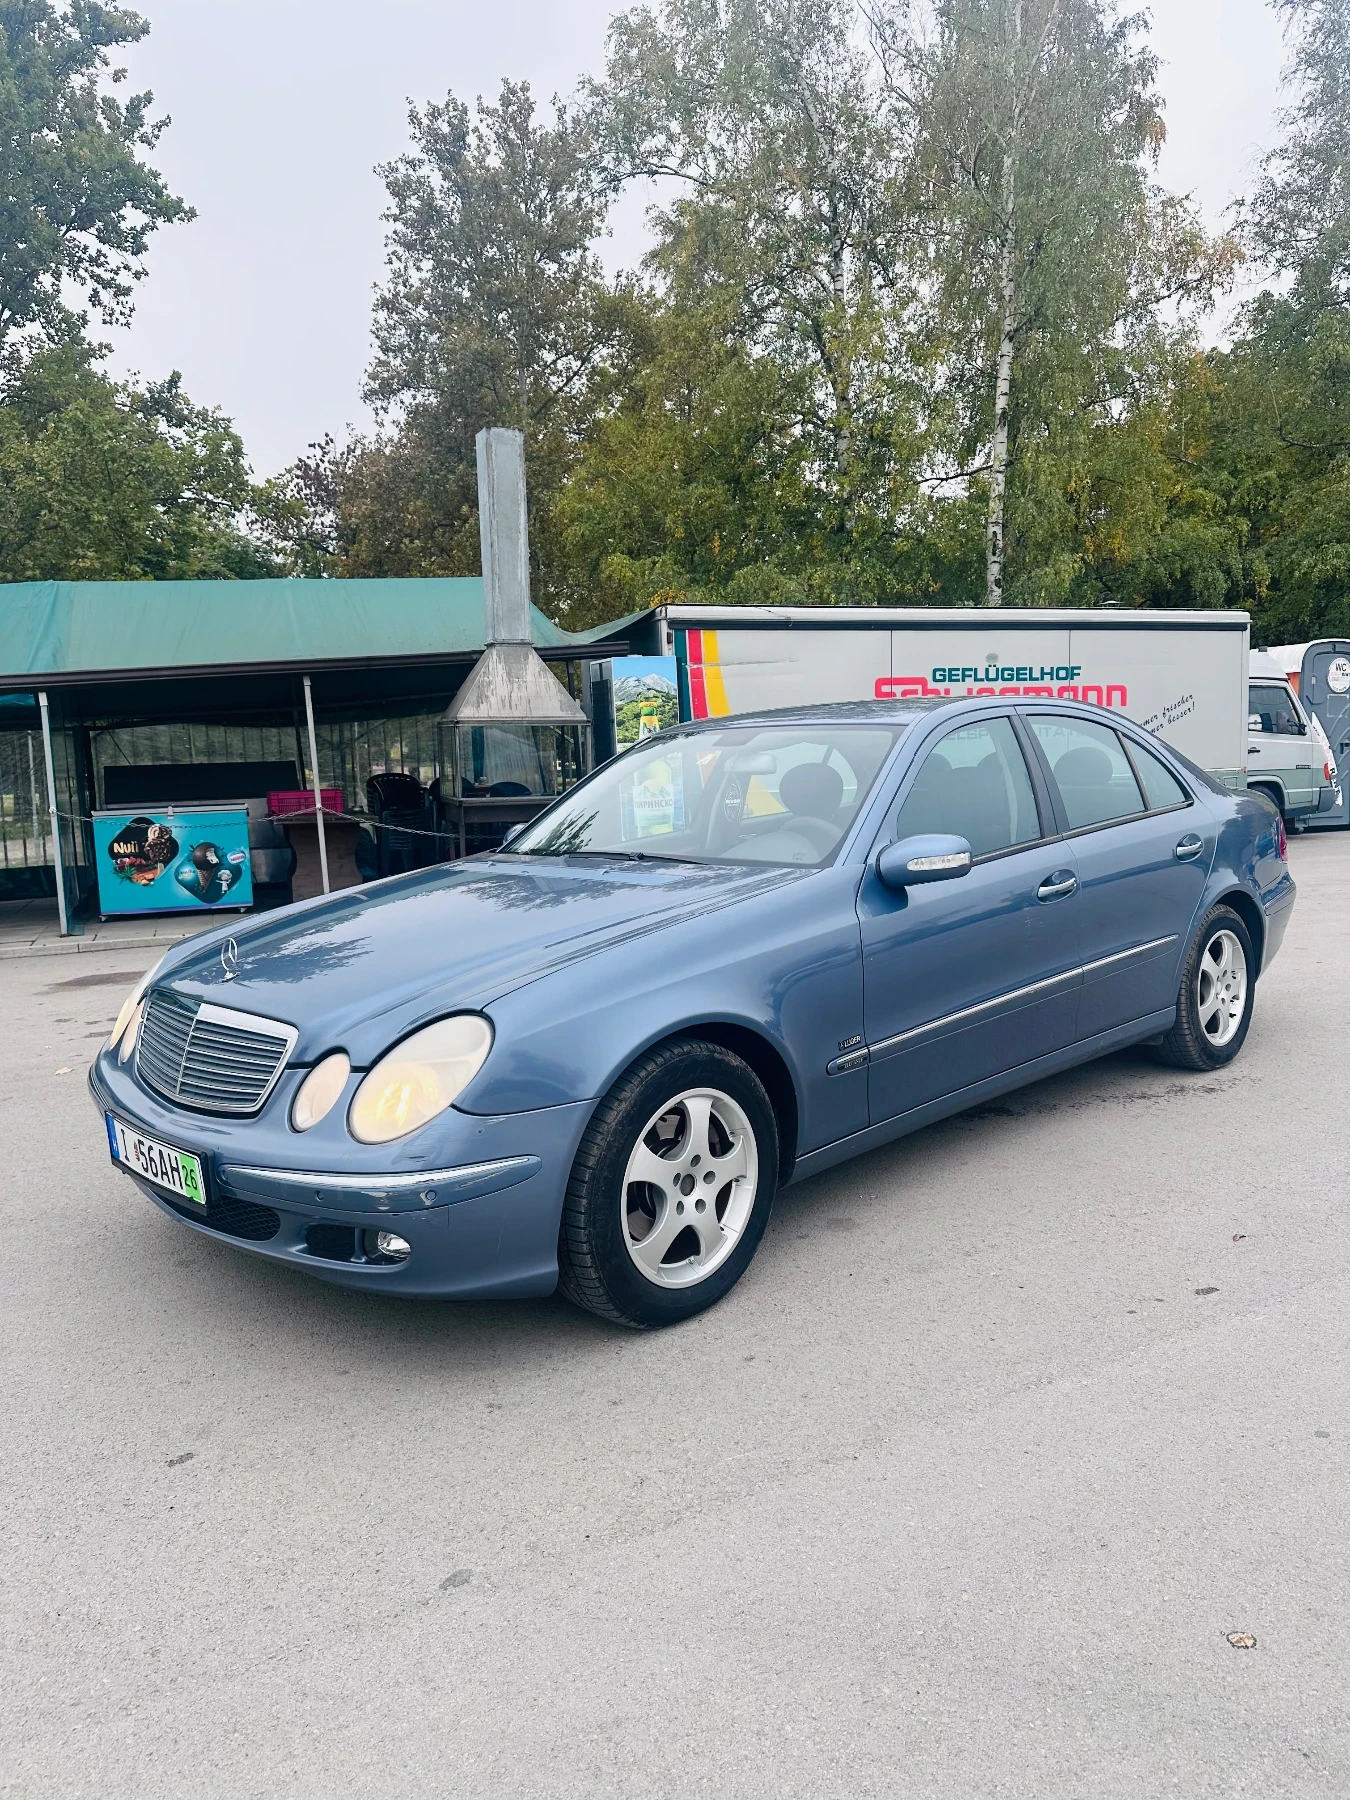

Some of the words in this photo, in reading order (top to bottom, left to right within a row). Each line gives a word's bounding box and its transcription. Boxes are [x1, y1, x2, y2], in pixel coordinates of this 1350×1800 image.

[932, 665, 1081, 684] GEFLÜGELHOF
[1335, 663, 1347, 672] WC
[1162, 694, 1194, 719] frischer
[1167, 701, 1195, 724] besser!
[181, 1164, 198, 1191] 26
